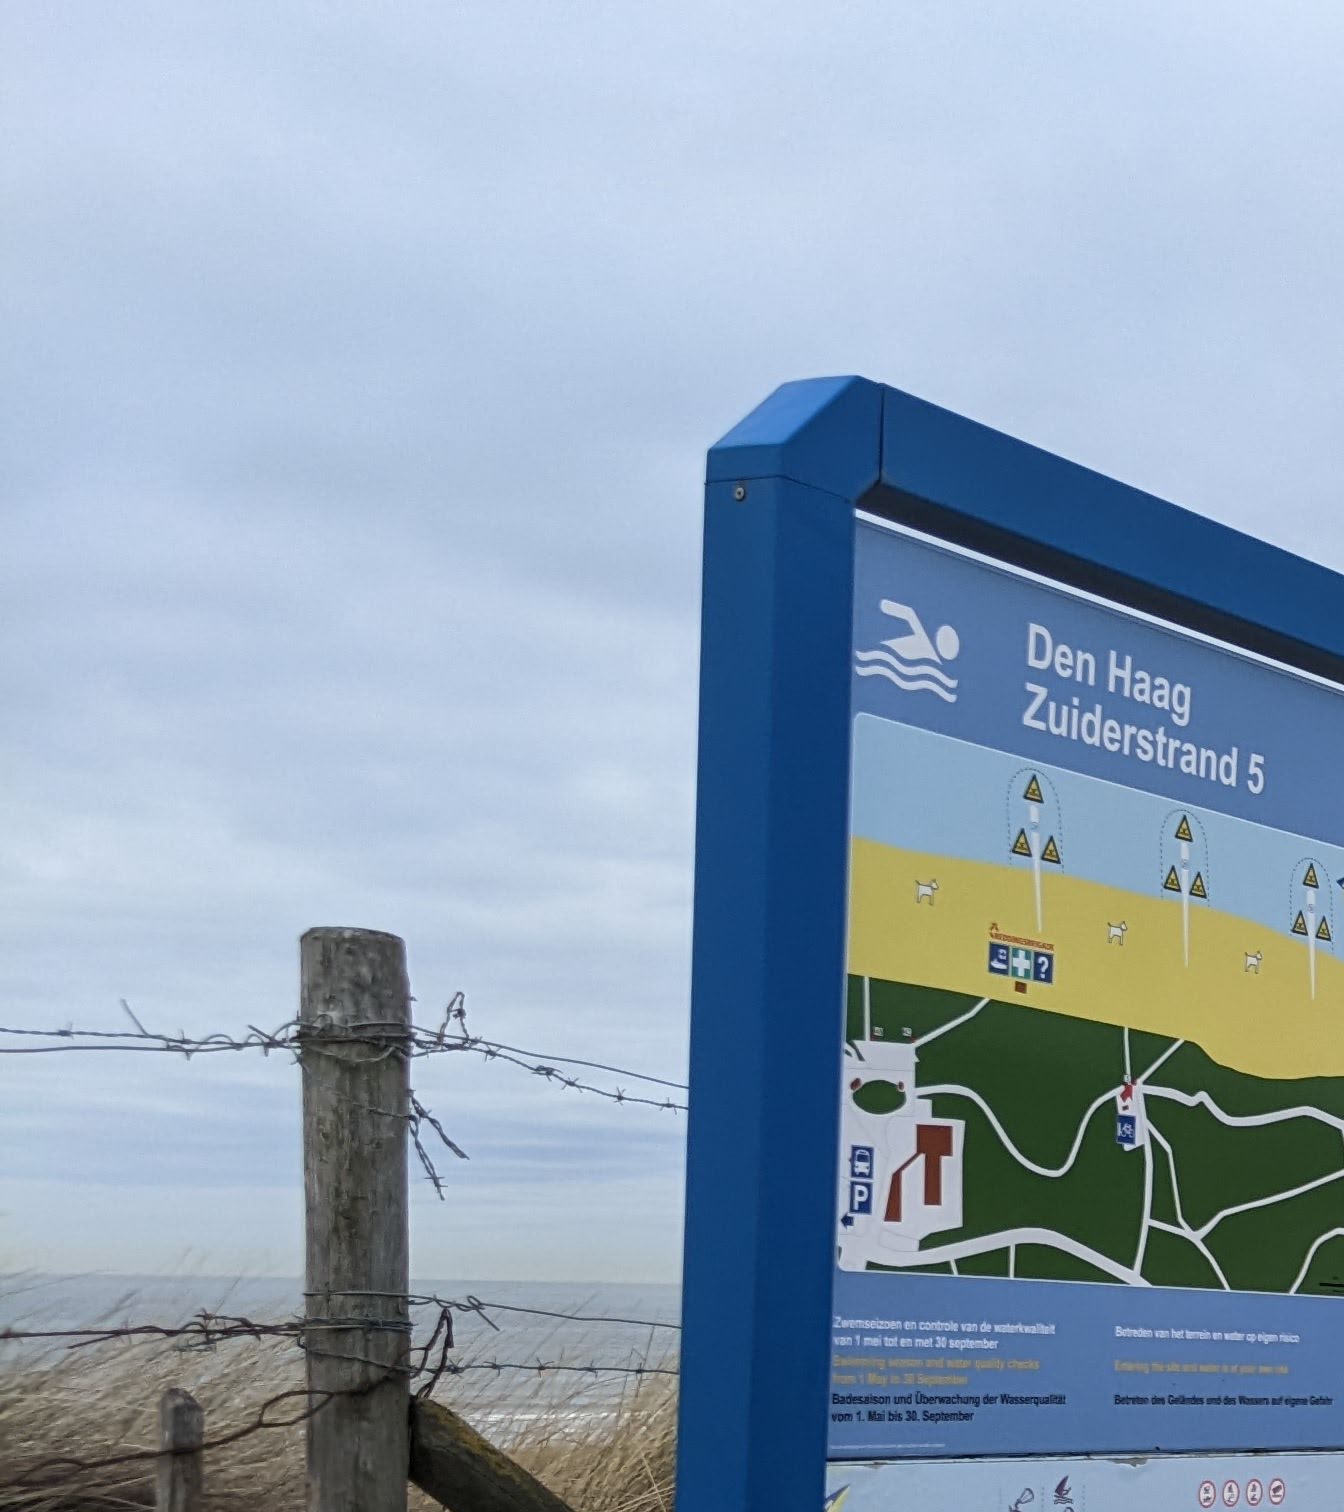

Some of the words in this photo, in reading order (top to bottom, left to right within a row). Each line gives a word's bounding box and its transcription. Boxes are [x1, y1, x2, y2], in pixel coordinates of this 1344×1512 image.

[1028, 622, 1095, 686] Den
[1108, 650, 1191, 727] Haag
[1022, 682, 1238, 788] Zuiderstrand
[1247, 753, 1265, 794] 5
[853, 1184, 868, 1211] P
[833, 1316, 901, 1330] Zwemseizoen
[904, 1320, 917, 1331] en
[919, 1320, 958, 1332] controle
[960, 1323, 978, 1333] van
[980, 1321, 992, 1333] de
[994, 1322, 1056, 1335] waterkwaliteit
[833, 1336, 853, 1346] van
[855, 1335, 861, 1346] 1
[863, 1335, 882, 1347] mei
[884, 1336, 899, 1347] tot
[900, 1337, 913, 1348] en
[915, 1336, 933, 1348] met
[935, 1336, 947, 1349] 30
[949, 1338, 999, 1350] september
[832, 1392, 891, 1405] Badesaison
[893, 1393, 913, 1405] und
[915, 1390, 980, 1408] Überwachung
[982, 1393, 999, 1405] der
[1000, 1393, 1067, 1408] Wasserqualität
[831, 1412, 853, 1423] vom
[855, 1410, 866, 1422] 1.
[868, 1410, 886, 1422] Mai
[888, 1410, 903, 1422] bis
[905, 1410, 920, 1422] 30.
[922, 1410, 975, 1424] September
